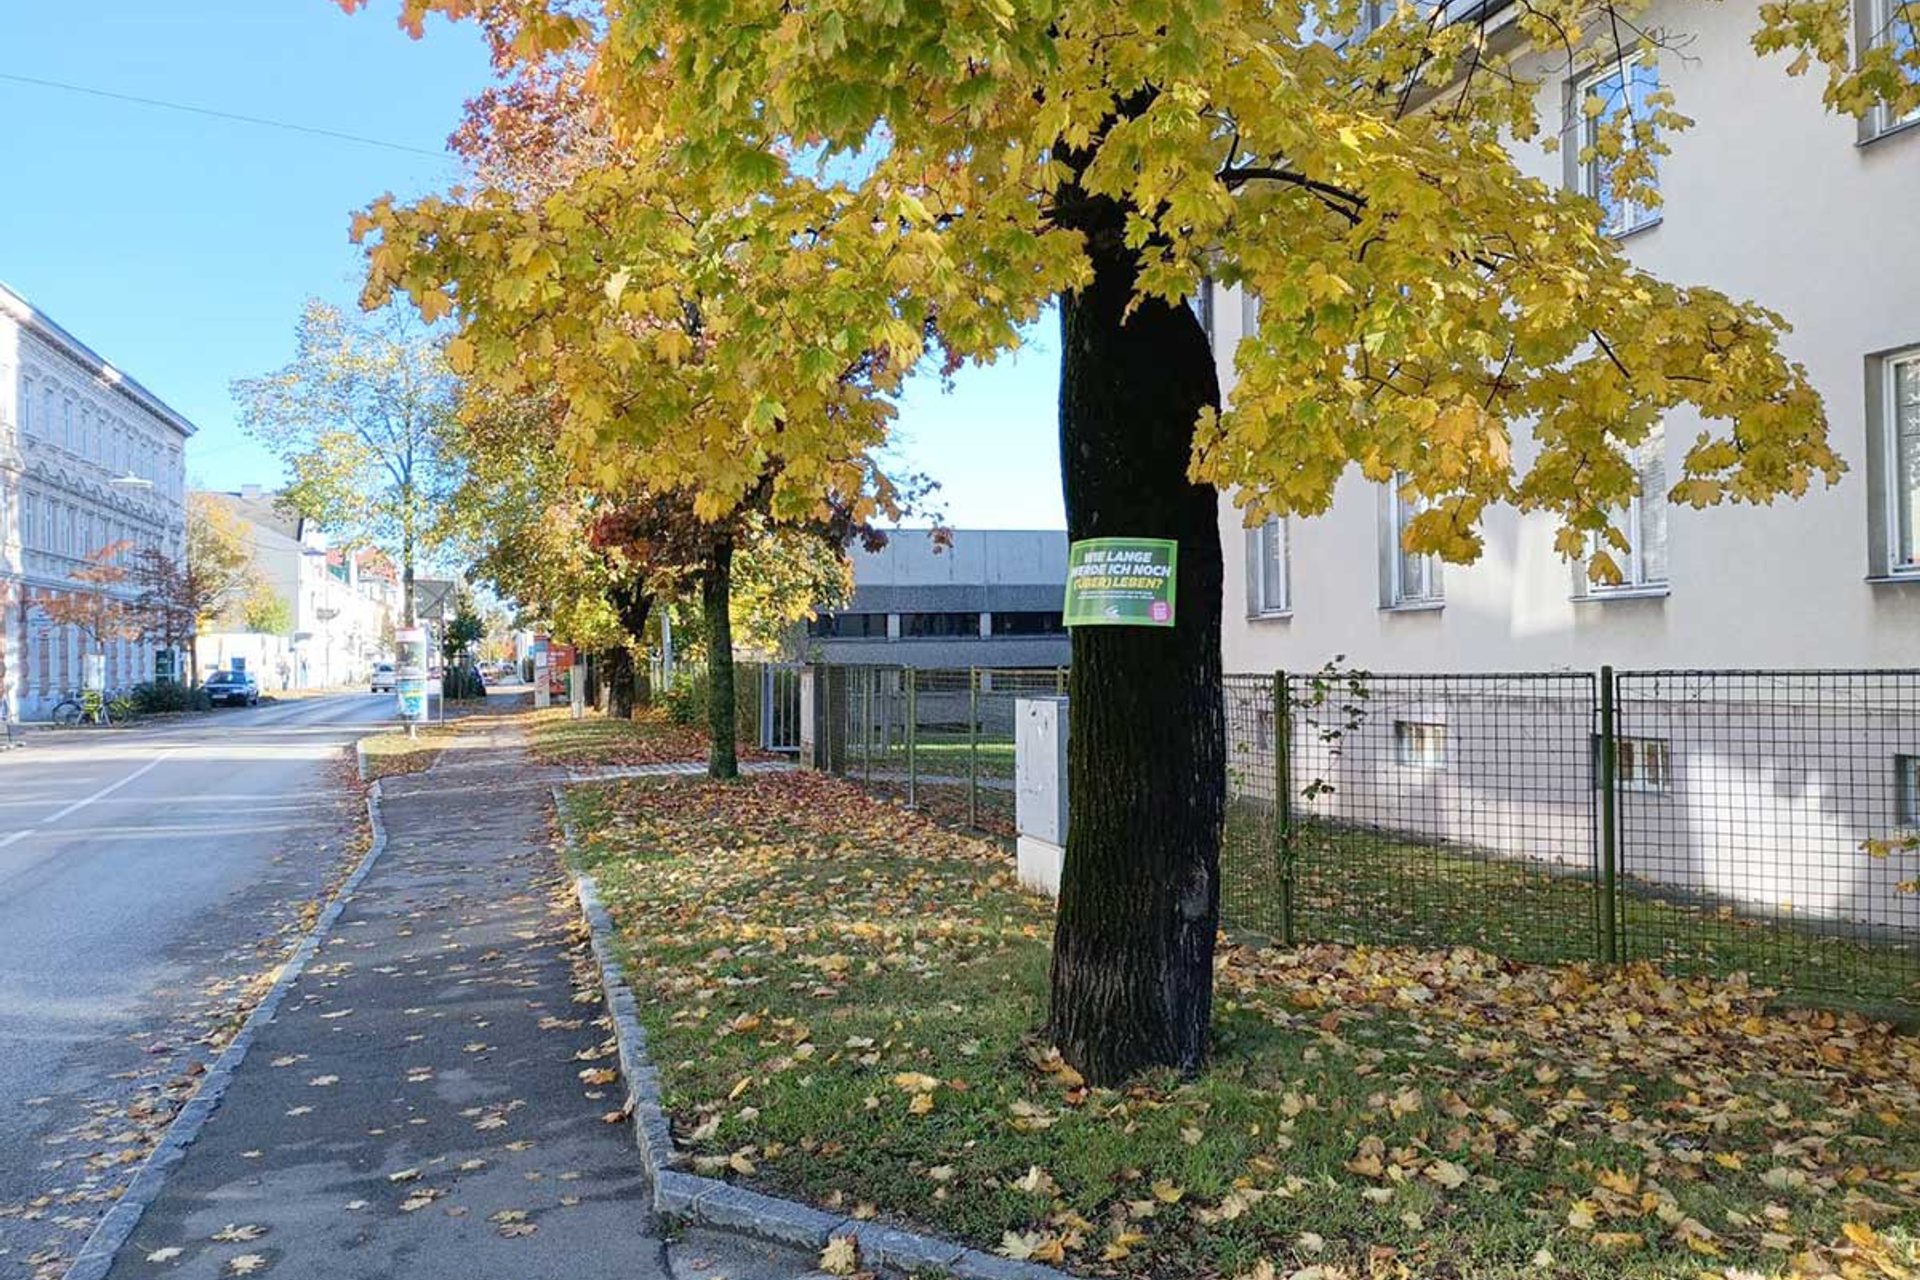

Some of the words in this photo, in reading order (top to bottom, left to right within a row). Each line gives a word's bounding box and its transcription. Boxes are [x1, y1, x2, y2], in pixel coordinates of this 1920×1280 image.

[1084, 551, 1106, 563] WIE
[1107, 551, 1153, 563] LANGE
[1071, 564, 1106, 577] WERDE
[1108, 564, 1131, 575] ICH
[1133, 565, 1172, 577] NOCH
